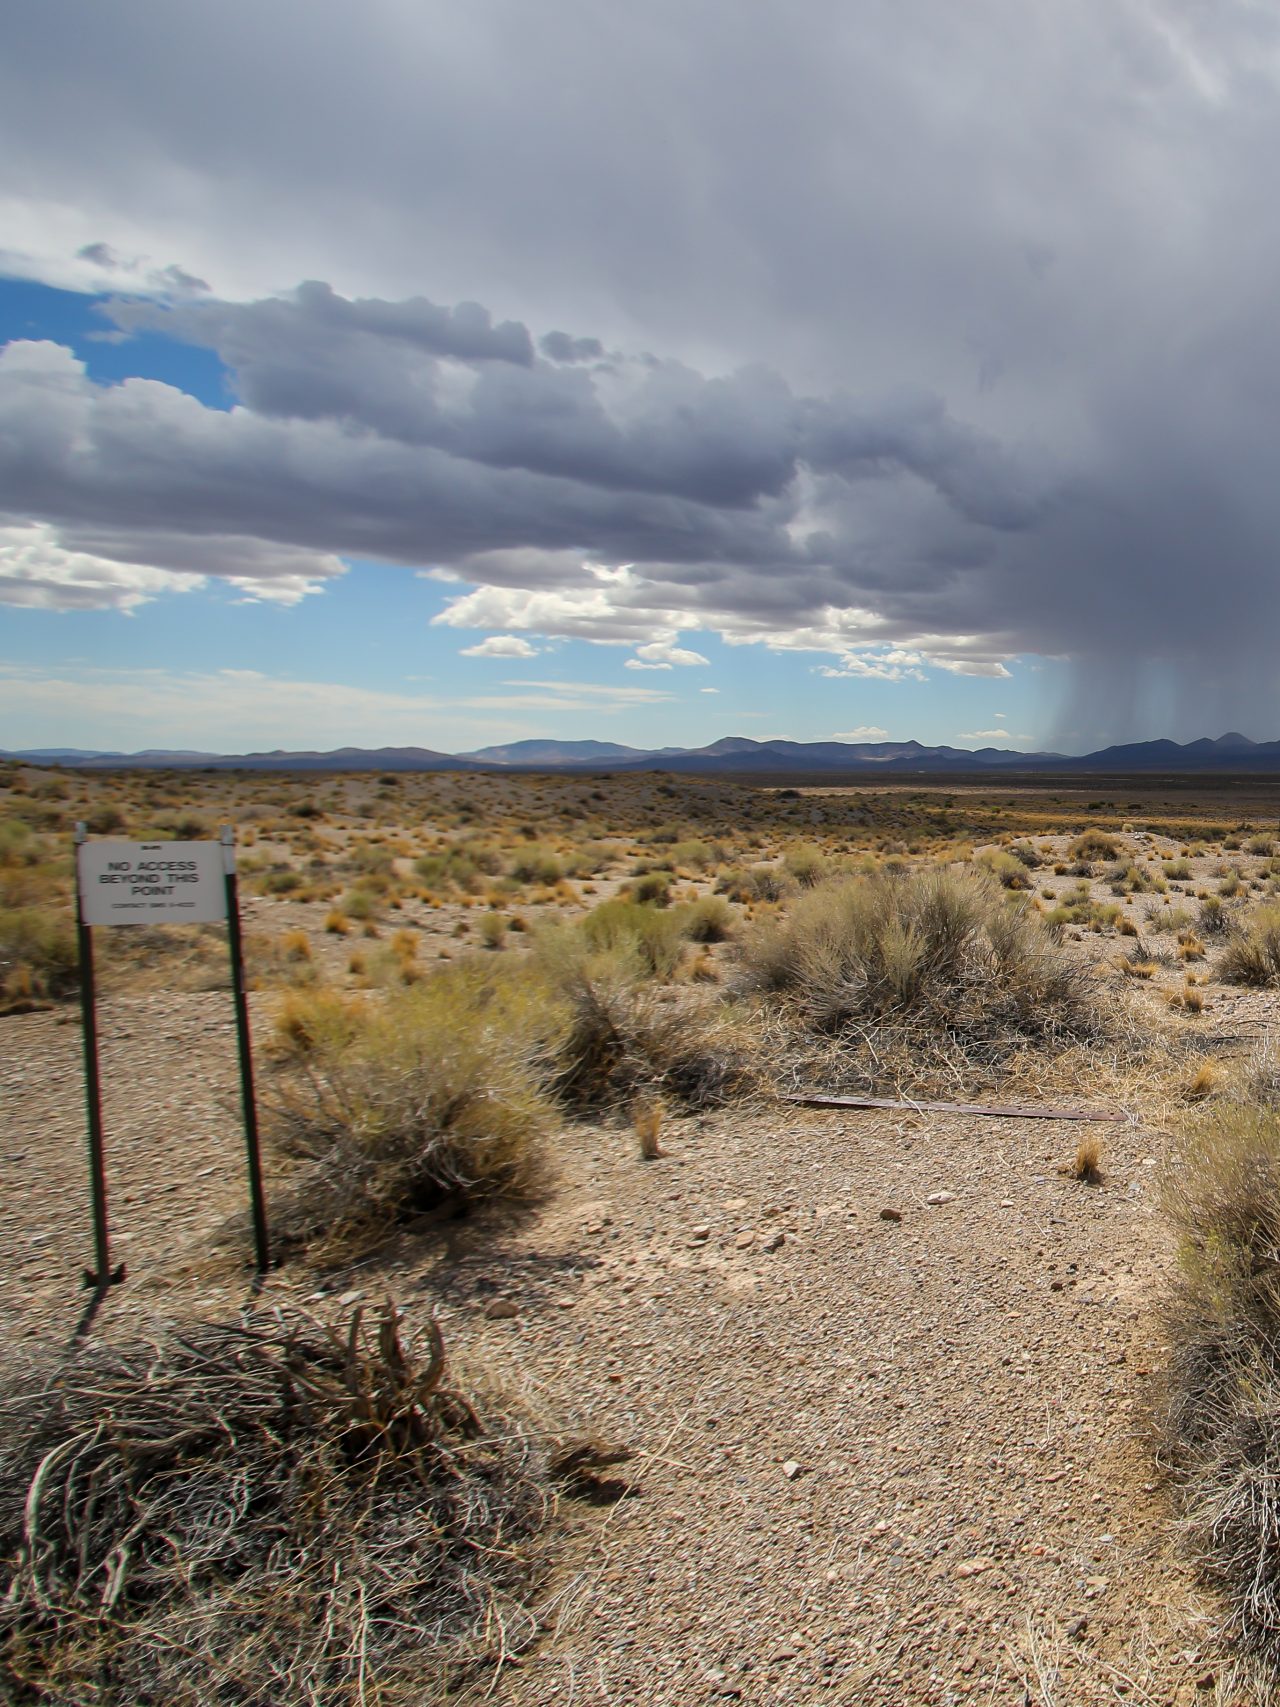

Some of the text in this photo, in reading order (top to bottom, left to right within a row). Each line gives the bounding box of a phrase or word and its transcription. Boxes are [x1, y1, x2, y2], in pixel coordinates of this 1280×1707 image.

[108, 861, 197, 871] NO ACCESS
[99, 873, 199, 884] BEYOND THIS
[132, 886, 175, 895] POINT
